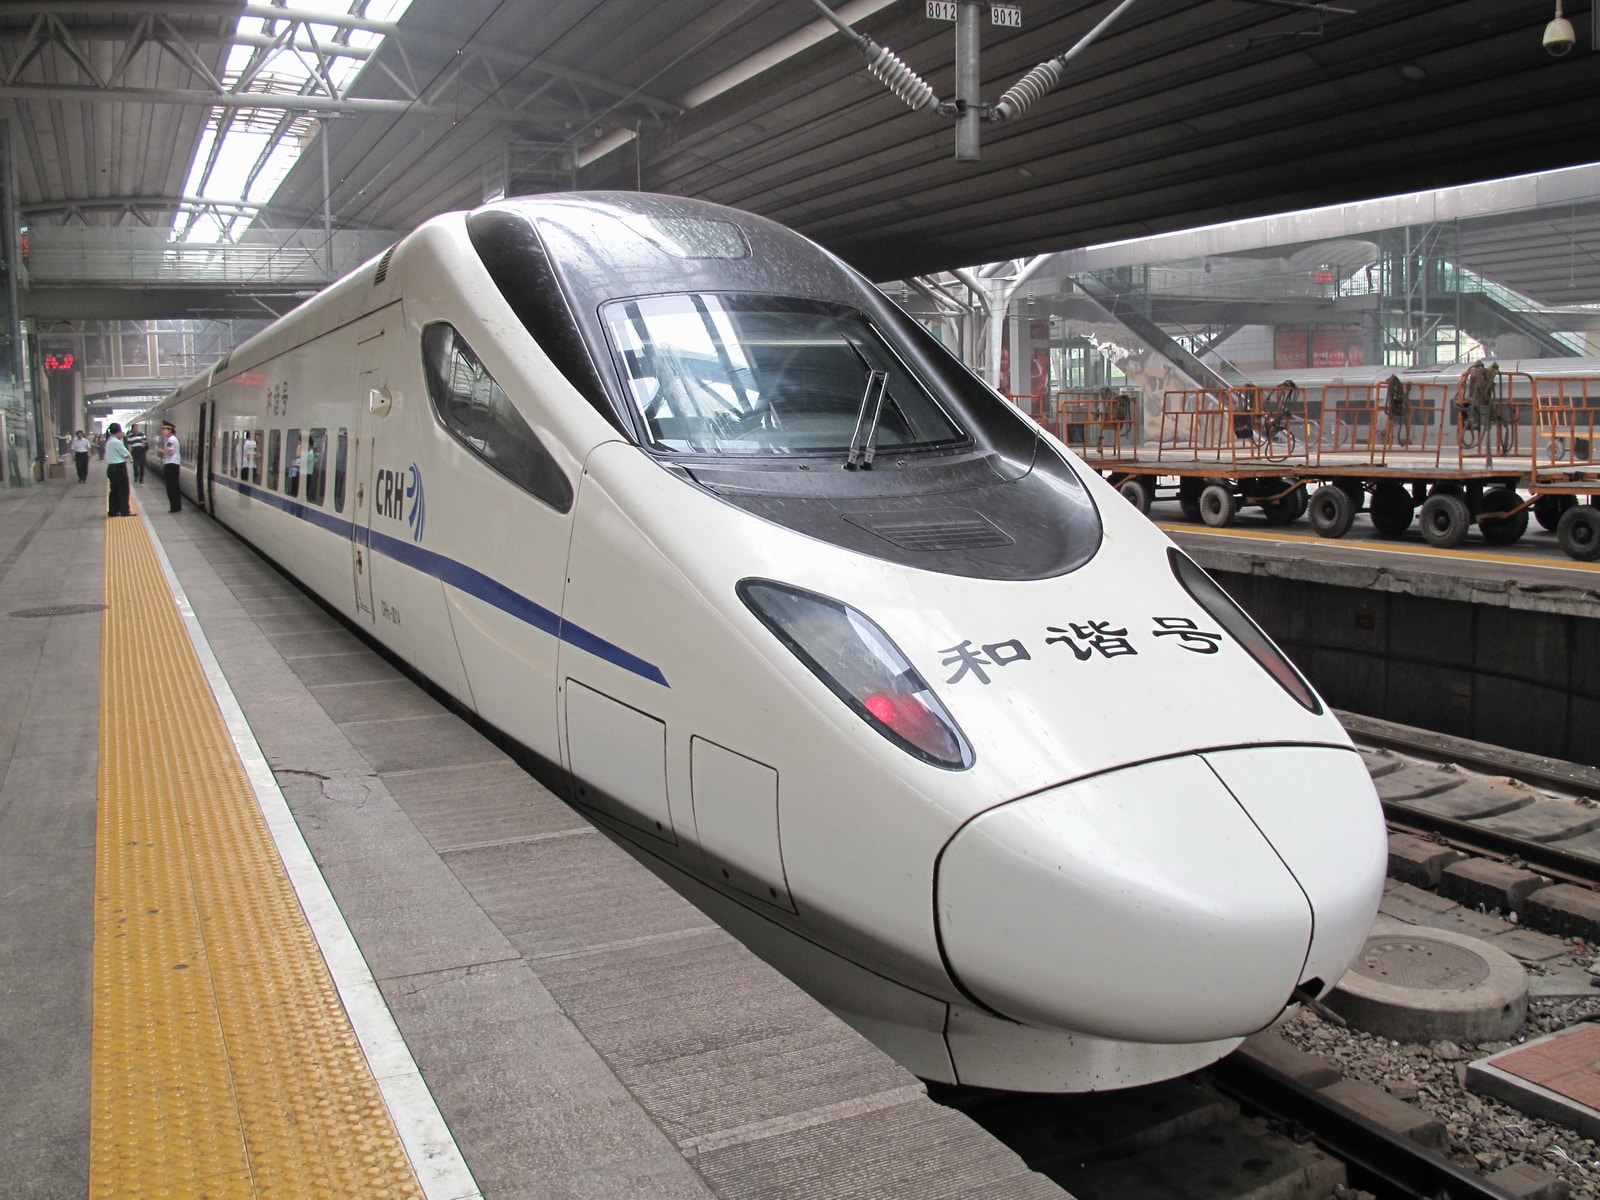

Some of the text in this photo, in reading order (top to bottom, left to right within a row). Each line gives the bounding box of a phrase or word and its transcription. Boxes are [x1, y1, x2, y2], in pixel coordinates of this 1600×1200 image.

[928, 2, 956, 20] 8012
[993, 8, 1020, 26] 9012
[375, 468, 405, 521] CRH
[937, 616, 1223, 685] 和谐号
